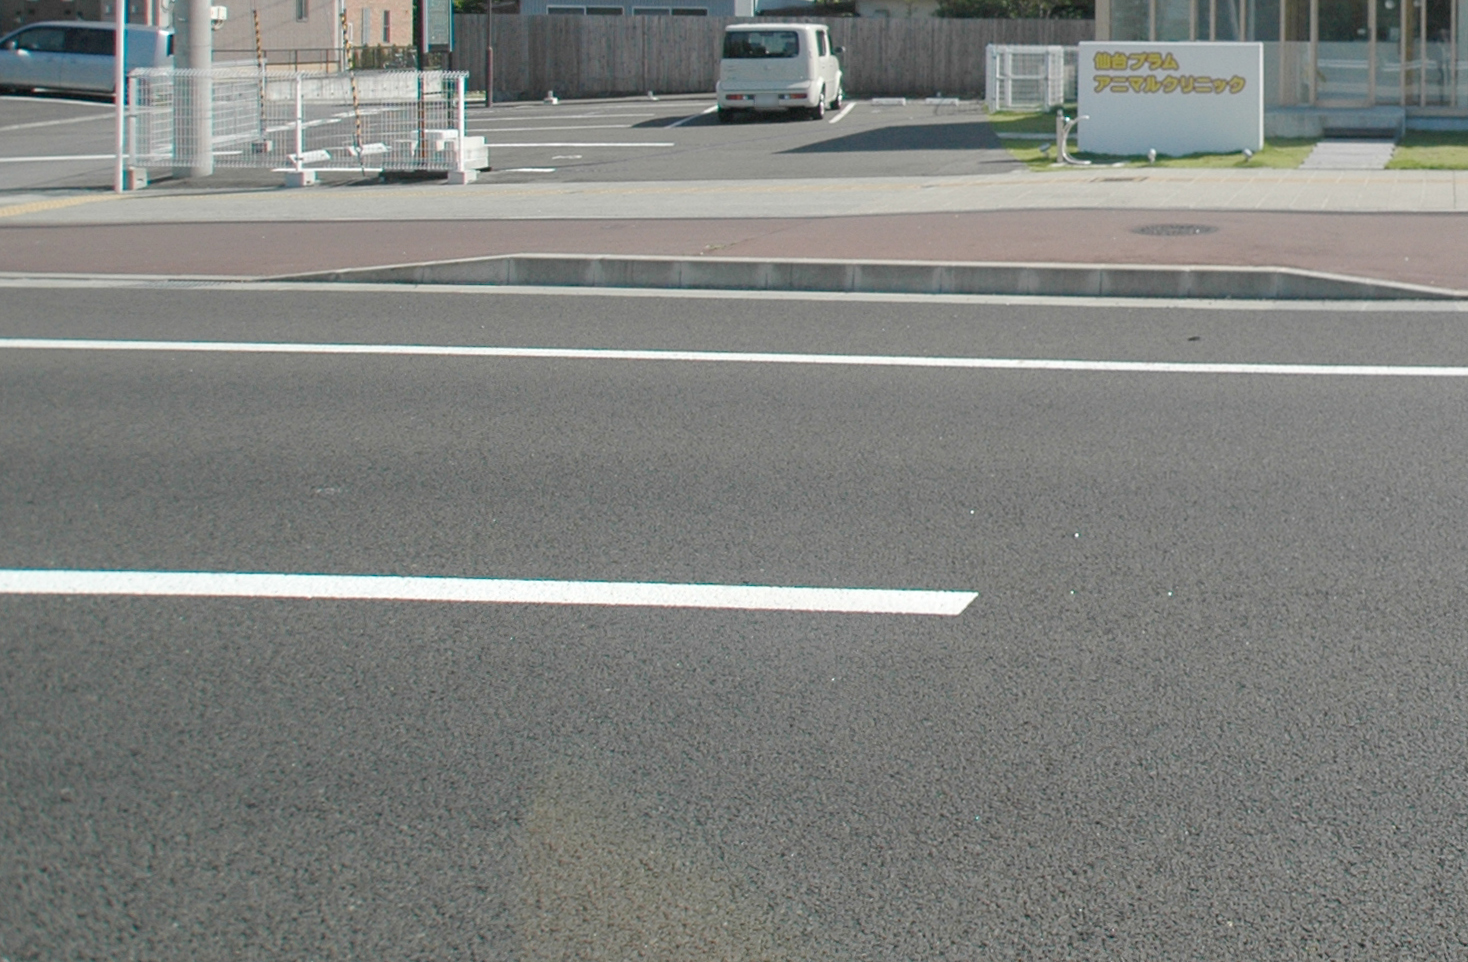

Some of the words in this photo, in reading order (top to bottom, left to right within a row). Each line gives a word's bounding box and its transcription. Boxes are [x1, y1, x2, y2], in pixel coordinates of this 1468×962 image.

[1094, 52, 1178, 70] 仙台プラム
[1094, 75, 1245, 93] アニマルクリニック
